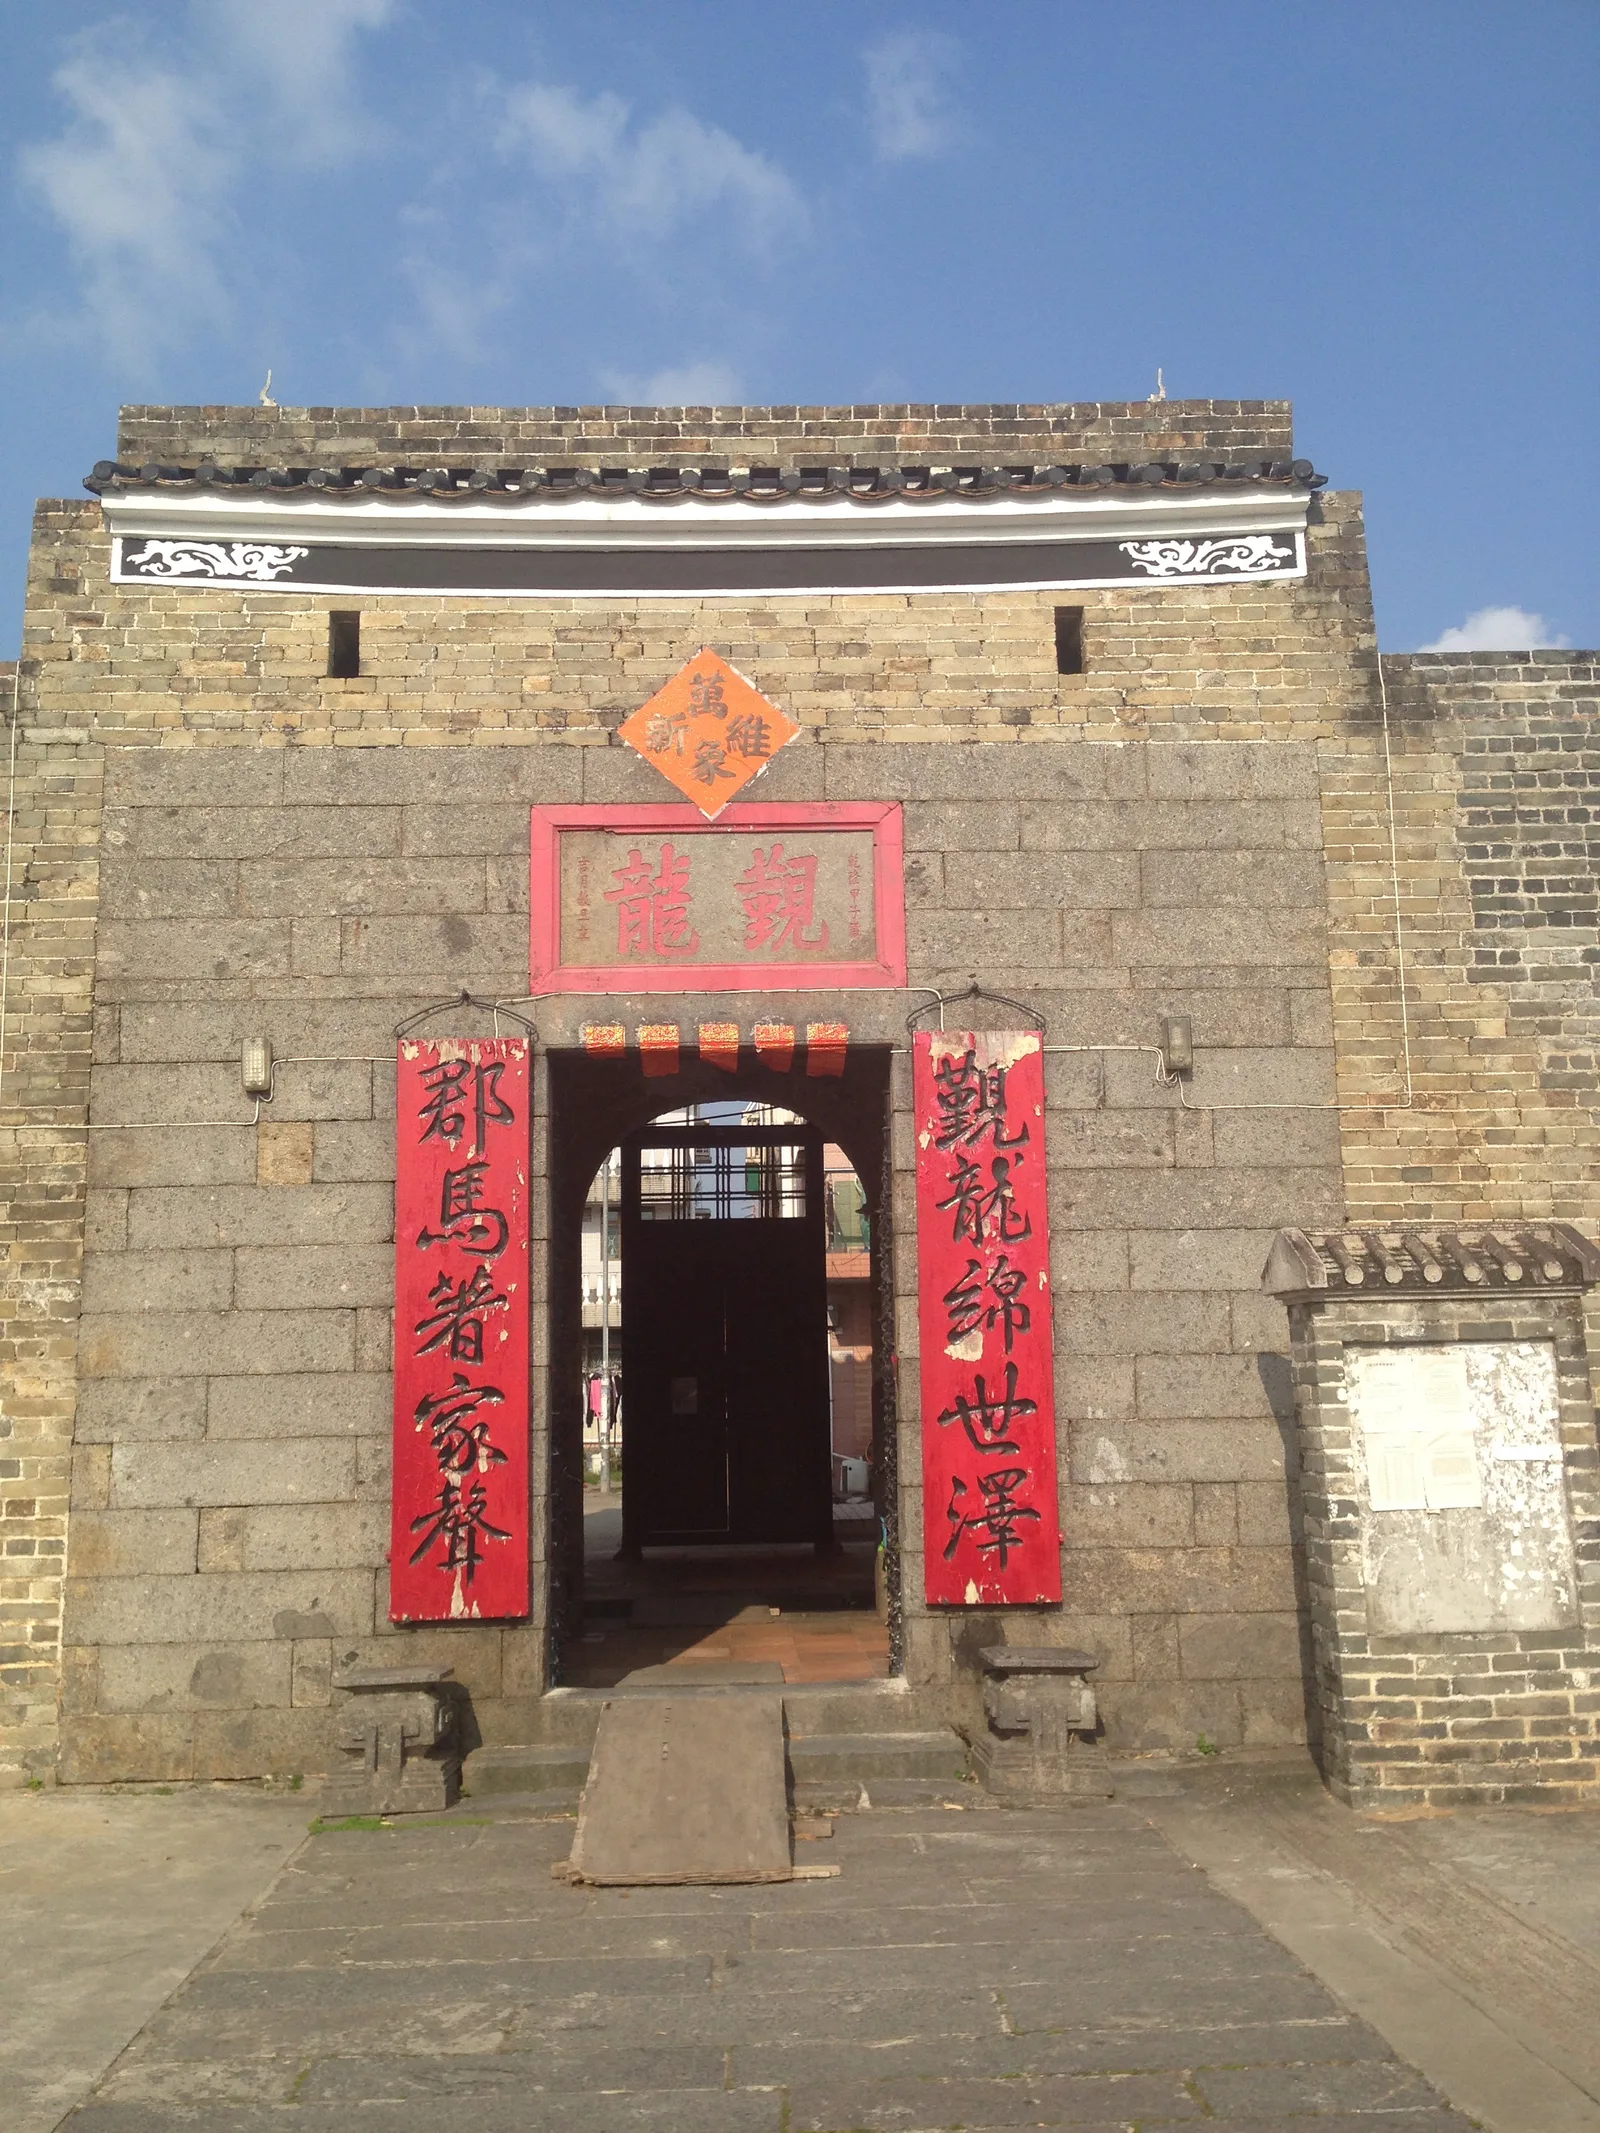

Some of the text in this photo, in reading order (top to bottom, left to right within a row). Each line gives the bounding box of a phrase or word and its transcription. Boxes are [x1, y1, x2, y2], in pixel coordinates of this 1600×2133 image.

[936, 1049, 1041, 1572] 觀龍綿世澤
